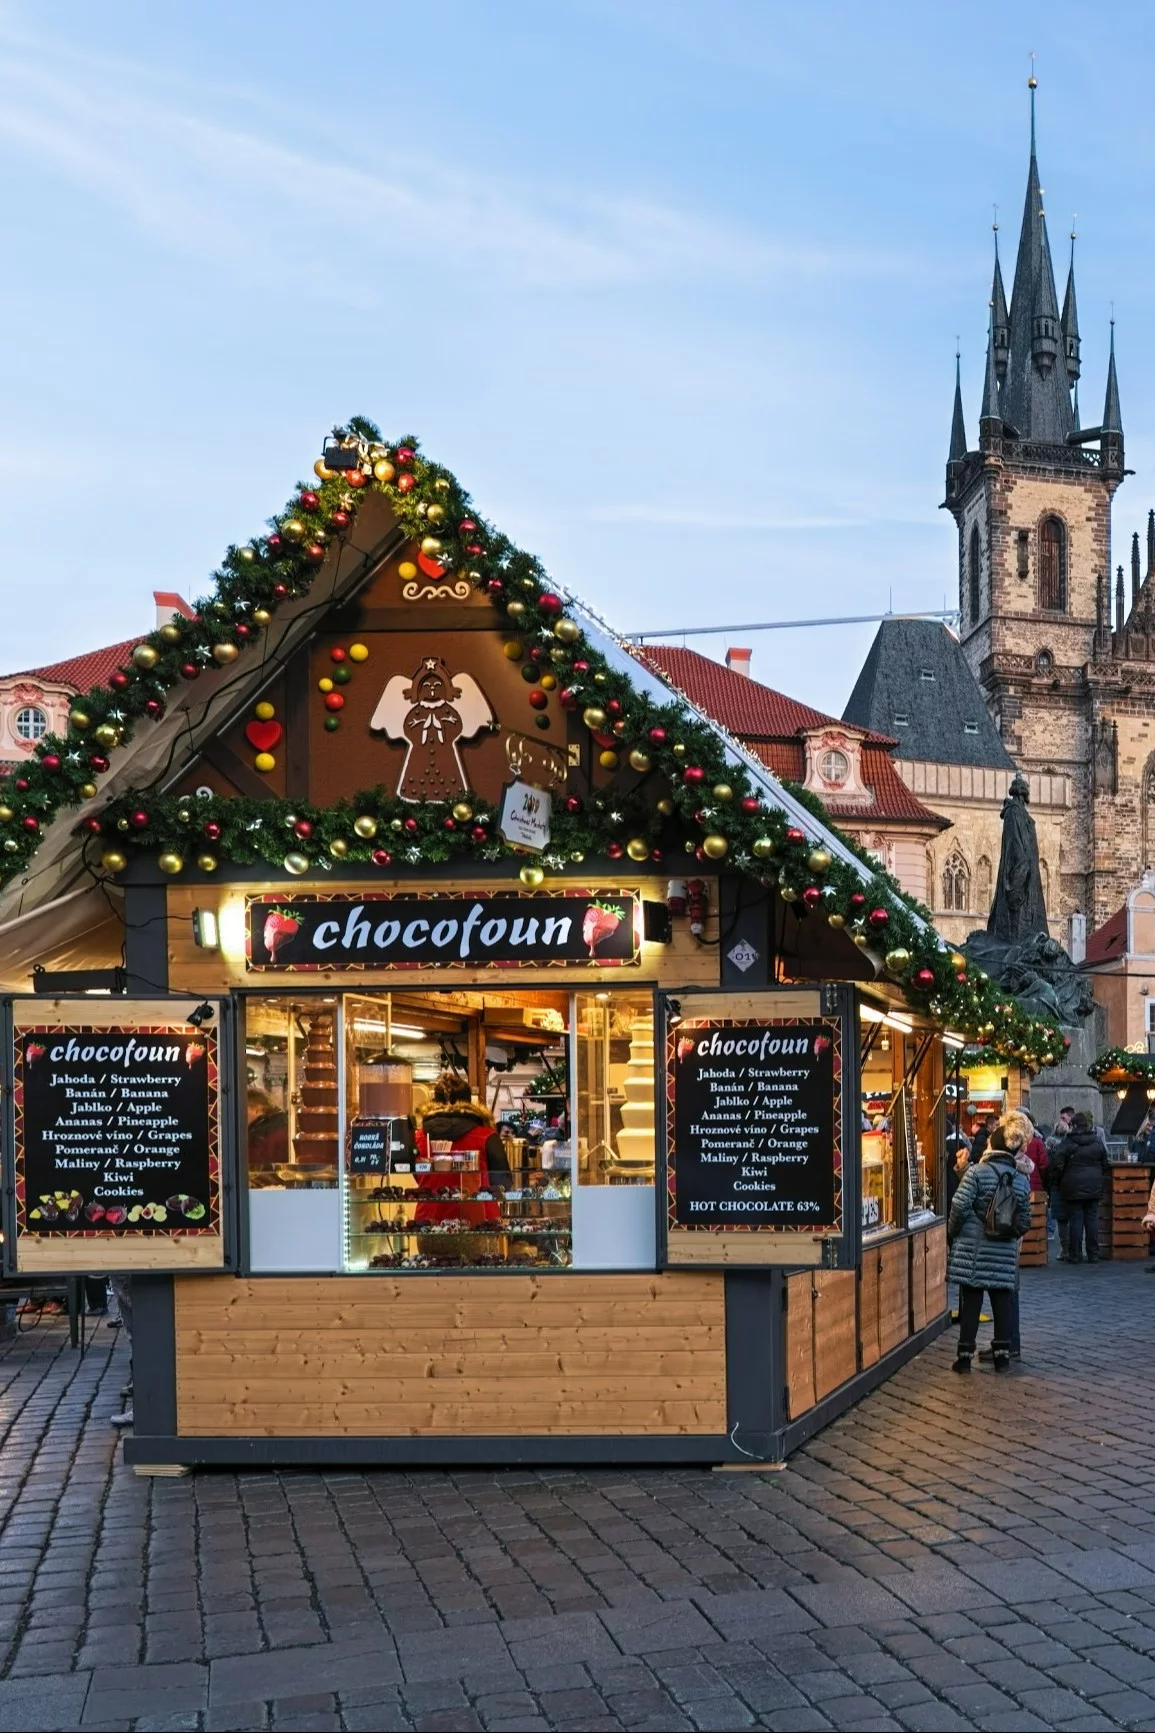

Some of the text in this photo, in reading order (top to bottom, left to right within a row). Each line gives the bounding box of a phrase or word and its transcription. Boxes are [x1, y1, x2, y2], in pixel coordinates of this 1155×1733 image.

[312, 903, 573, 958] chocofoun
[50, 1038, 180, 1067] chocofoun
[697, 1031, 808, 1060] chocofoun
[50, 1073, 95, 1087] Jahoda
[111, 1073, 181, 1087] Strawberry
[697, 1067, 735, 1082] Jahoda
[749, 1066, 809, 1080] Strawberry
[66, 1087, 106, 1098] Banán
[122, 1087, 168, 1098] Banana
[710, 1082, 744, 1093] Banán
[758, 1081, 798, 1092] Banana
[70, 1101, 112, 1115] Jablko
[127, 1101, 162, 1115] Apple
[714, 1096, 749, 1109] Jablko
[762, 1095, 792, 1108] Apple
[56, 1116, 102, 1127] Ananas
[118, 1115, 178, 1129] Pineapple
[702, 1110, 741, 1121] Ananas
[755, 1109, 807, 1123] Pineapple
[42, 1130, 102, 1141] Hroznové
[106, 1130, 133, 1140] víno
[148, 1129, 192, 1143] Grapes
[691, 1124, 741, 1135] Hroznové
[744, 1124, 767, 1134] víno
[780, 1123, 819, 1137] Grapes
[56, 1144, 118, 1155] Pomeranč
[134, 1143, 180, 1157] Orange
[702, 1138, 754, 1149] Pomeranč
[768, 1137, 808, 1151] Orange
[55, 1158, 100, 1171] Maliny
[115, 1157, 181, 1171] Raspberry
[701, 1152, 738, 1166] Maliny
[752, 1152, 808, 1165] Raspberry
[104, 1171, 133, 1183] Kiwi
[742, 1166, 767, 1177] Kiwi
[94, 1186, 143, 1197] Cookies
[734, 1180, 775, 1191] Cookies
[690, 1200, 819, 1212] HOT CHOCOLATE 63%
